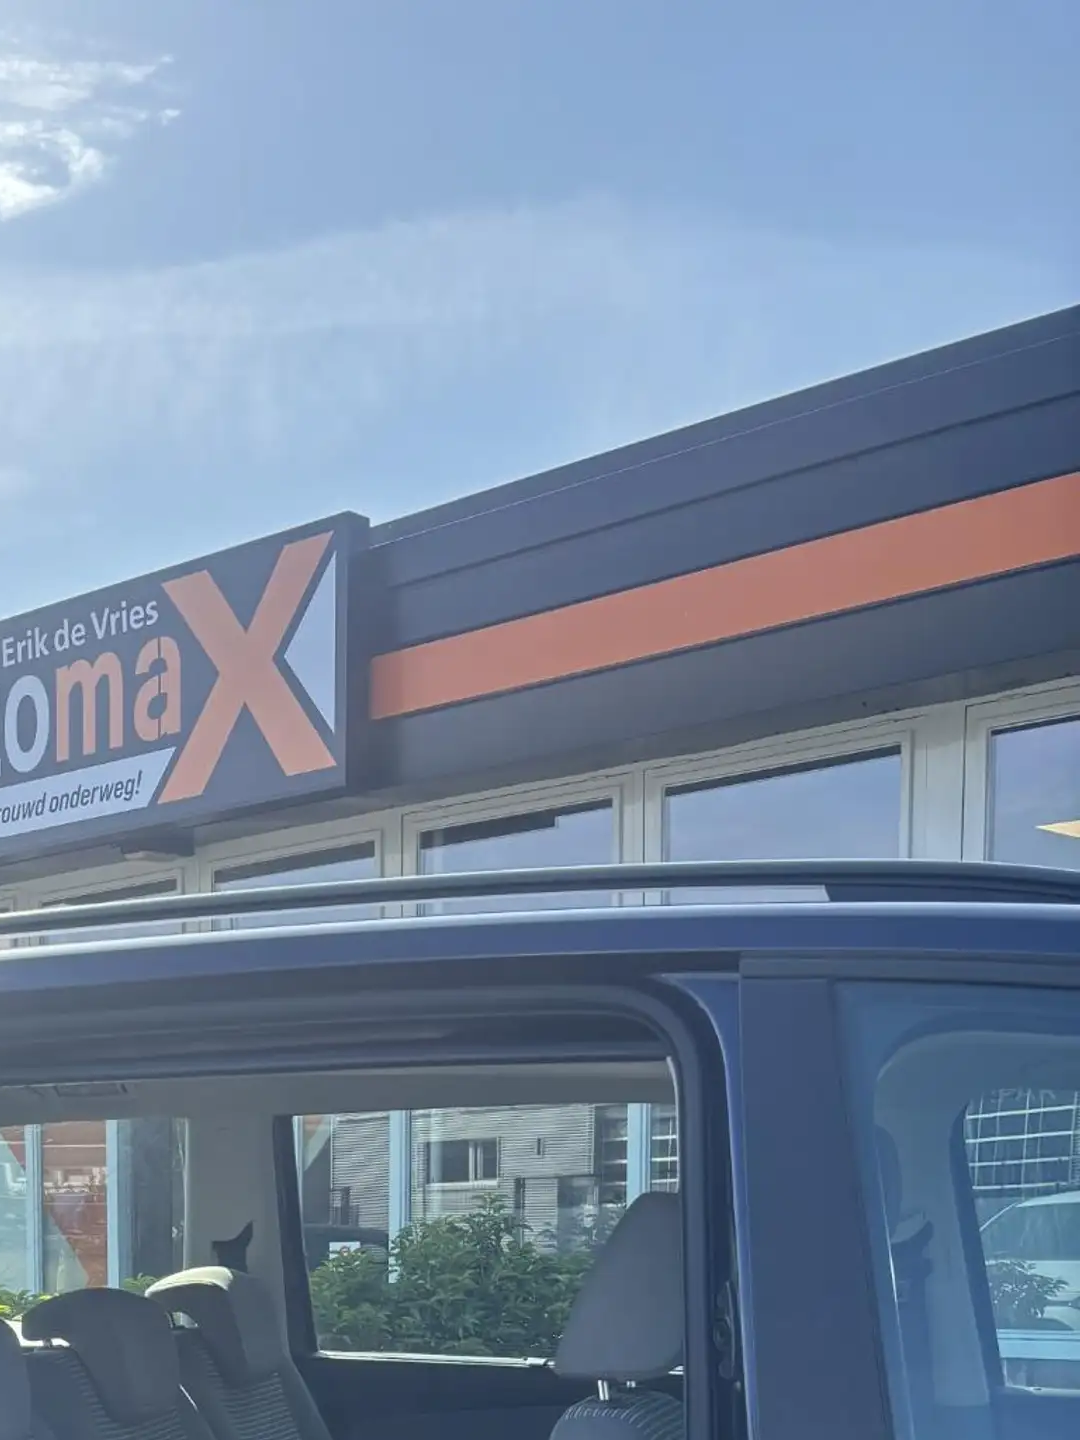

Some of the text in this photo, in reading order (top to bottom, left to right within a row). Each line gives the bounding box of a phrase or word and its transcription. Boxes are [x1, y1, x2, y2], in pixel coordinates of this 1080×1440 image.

[1, 600, 159, 668] Erik de Vries
[49, 769, 142, 812] onderweg!
